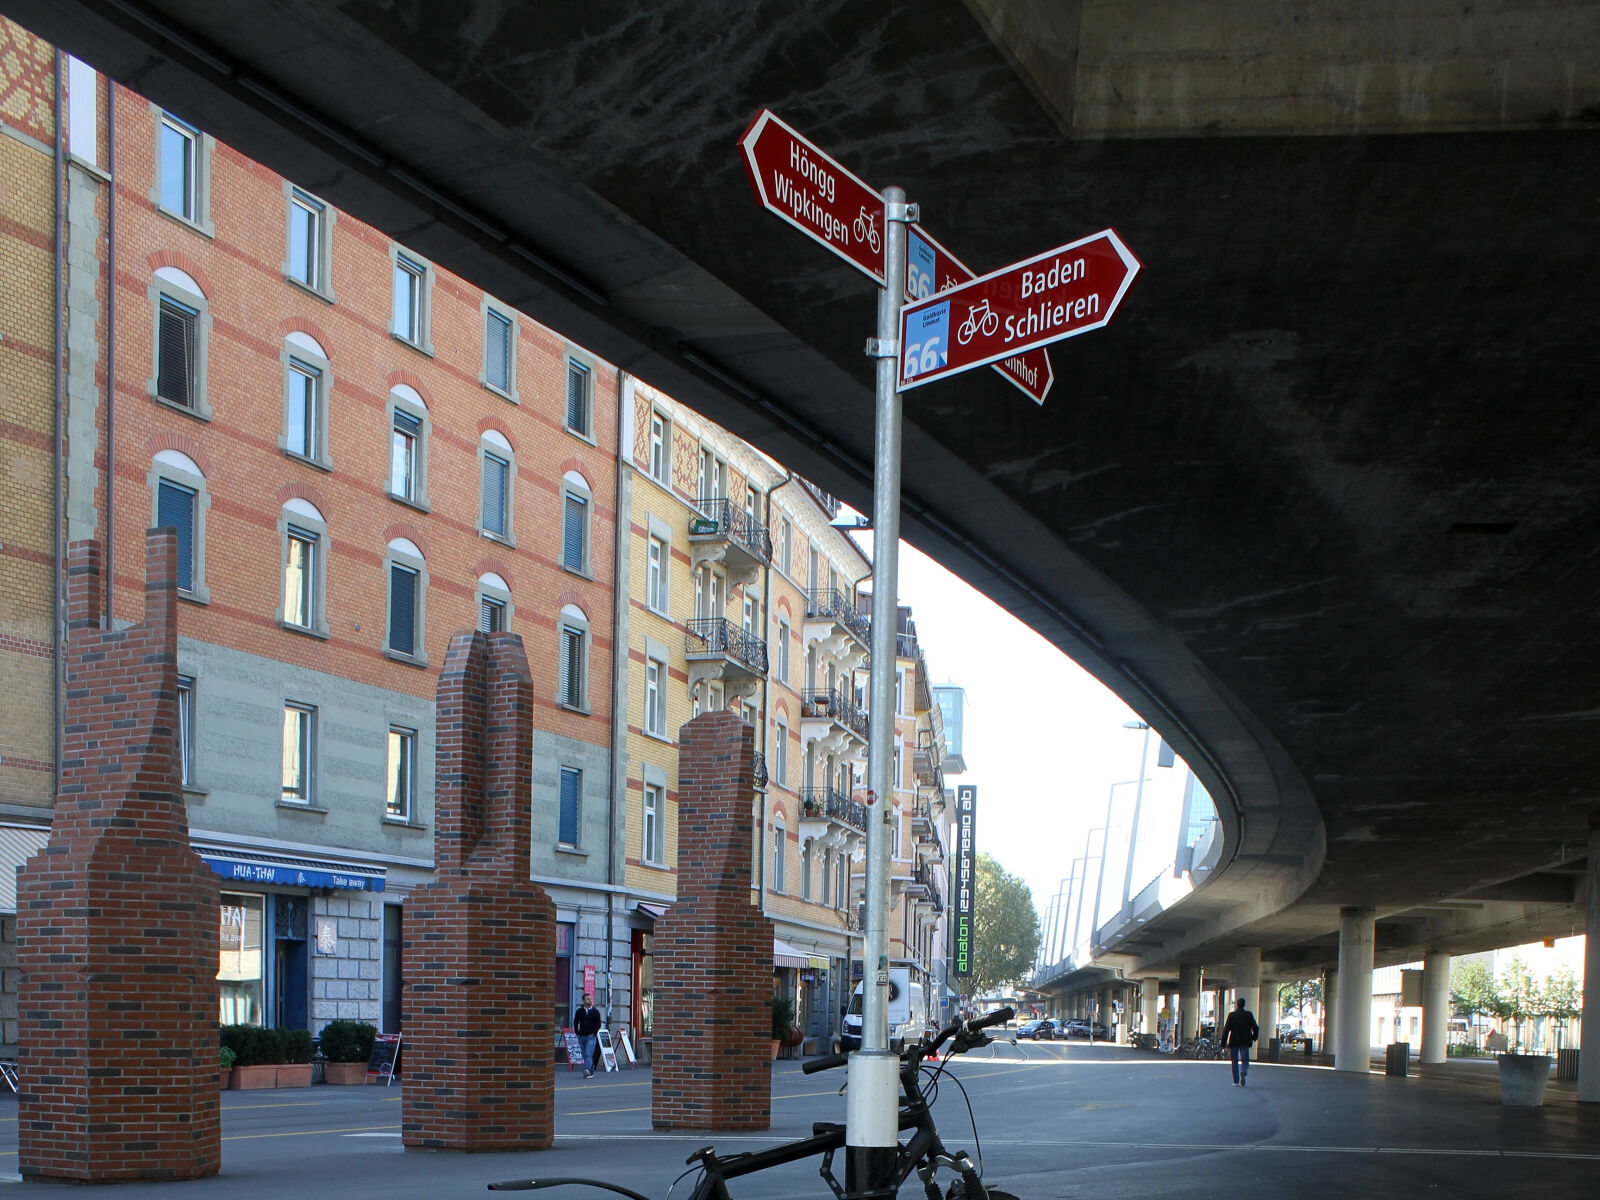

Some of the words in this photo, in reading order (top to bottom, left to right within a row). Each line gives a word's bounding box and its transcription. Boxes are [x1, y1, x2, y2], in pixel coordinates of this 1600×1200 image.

[790, 140, 835, 203] Höngg
[774, 169, 849, 245] Wipkingen
[908, 263, 930, 299] 66
[1022, 258, 1086, 299] Baden
[1004, 293, 1099, 342] Schlieren
[904, 336, 940, 379] 66
[233, 864, 275, 881] HUA-THAI
[332, 875, 348, 886] Take
[348, 879, 365, 890] away
[220, 905, 247, 928] HAI
[957, 916, 969, 972] abaton
